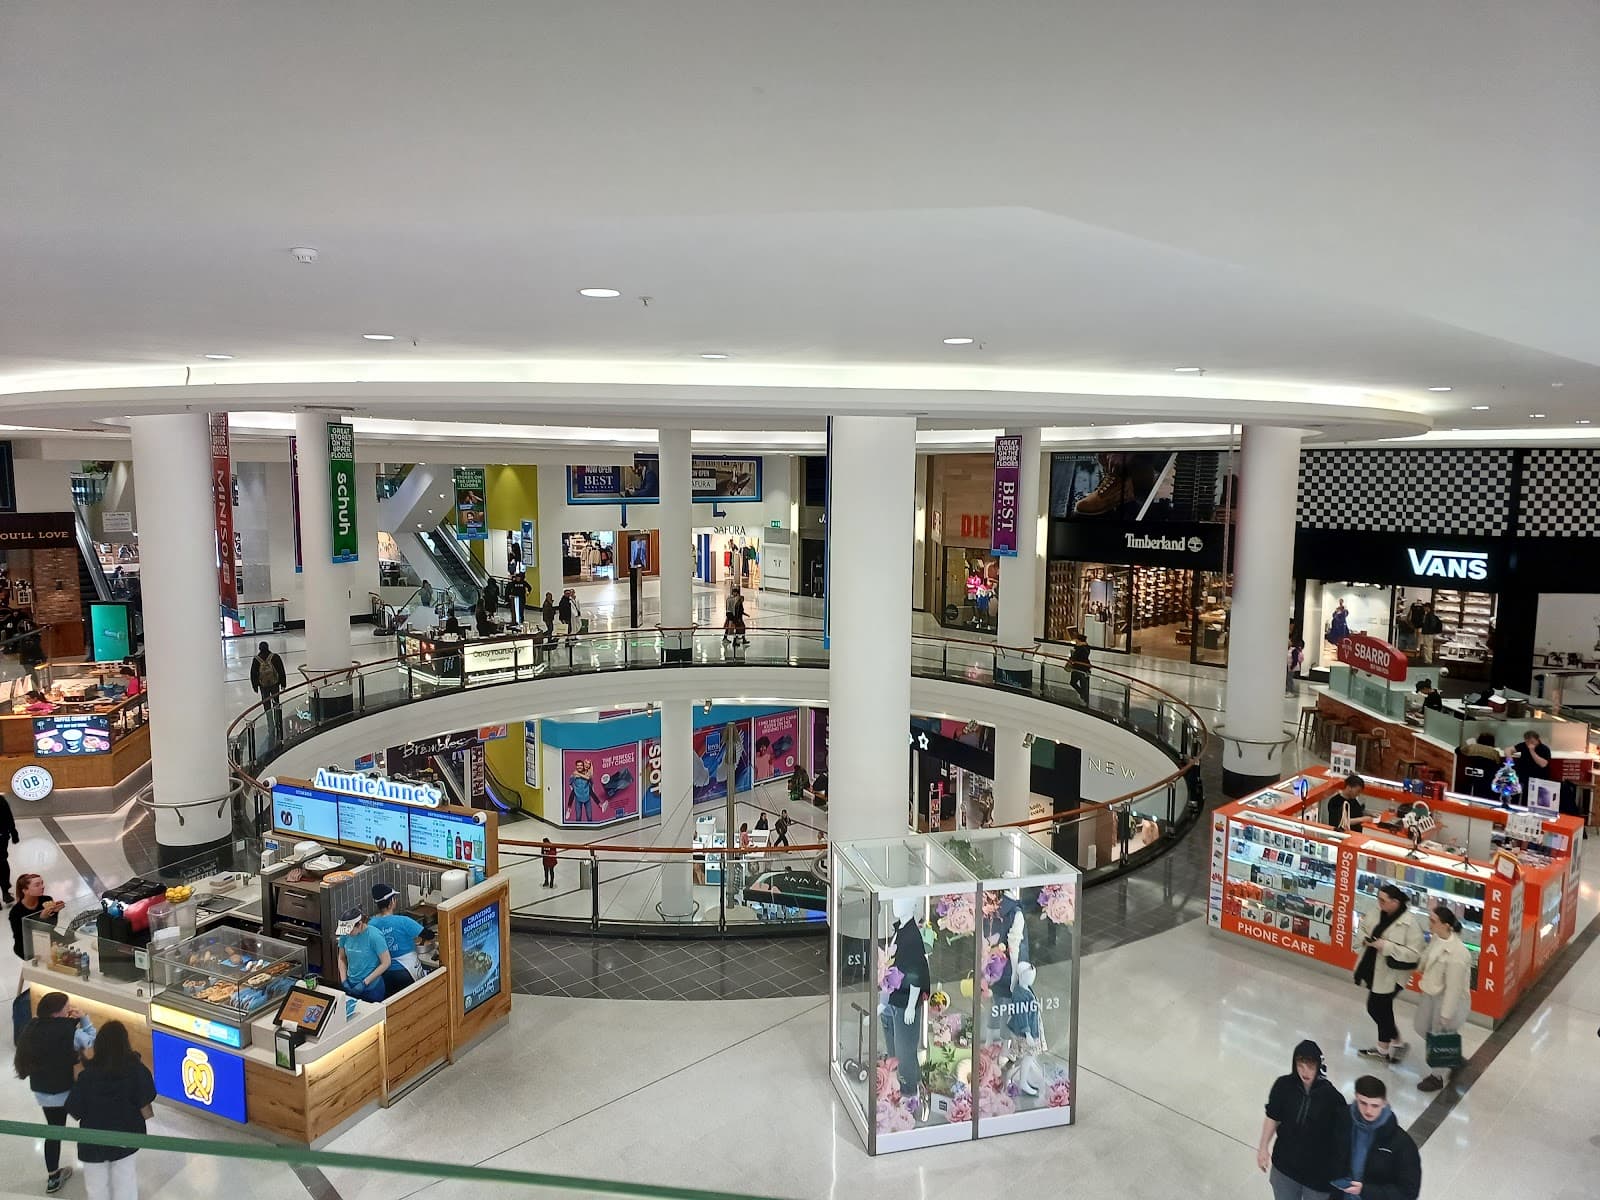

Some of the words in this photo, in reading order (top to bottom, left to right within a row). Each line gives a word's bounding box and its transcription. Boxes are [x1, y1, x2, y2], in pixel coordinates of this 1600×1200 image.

[584, 475, 613, 486] BEST
[692, 480, 711, 488] AFURA
[217, 470, 229, 557] MINISO
[337, 472, 351, 535] schuh
[1001, 481, 1015, 532] BEST
[39, 531, 69, 539] LOVE
[713, 525, 746, 536] SAFURA
[960, 513, 990, 539] DIE
[1125, 532, 1186, 551] Timberland
[1407, 548, 1488, 580] VANS
[1354, 642, 1390, 667] SBARRO
[1089, 757, 1136, 780] NEW
[1339, 851, 1353, 892] Screen
[1335, 893, 1350, 947] Protector
[1238, 922, 1278, 943] PHONE
[1281, 936, 1315, 955] CARE
[1485, 889, 1502, 992] REPAIR
[991, 1000, 1037, 1017] SPRING
[1046, 998, 1060, 1010] 23
